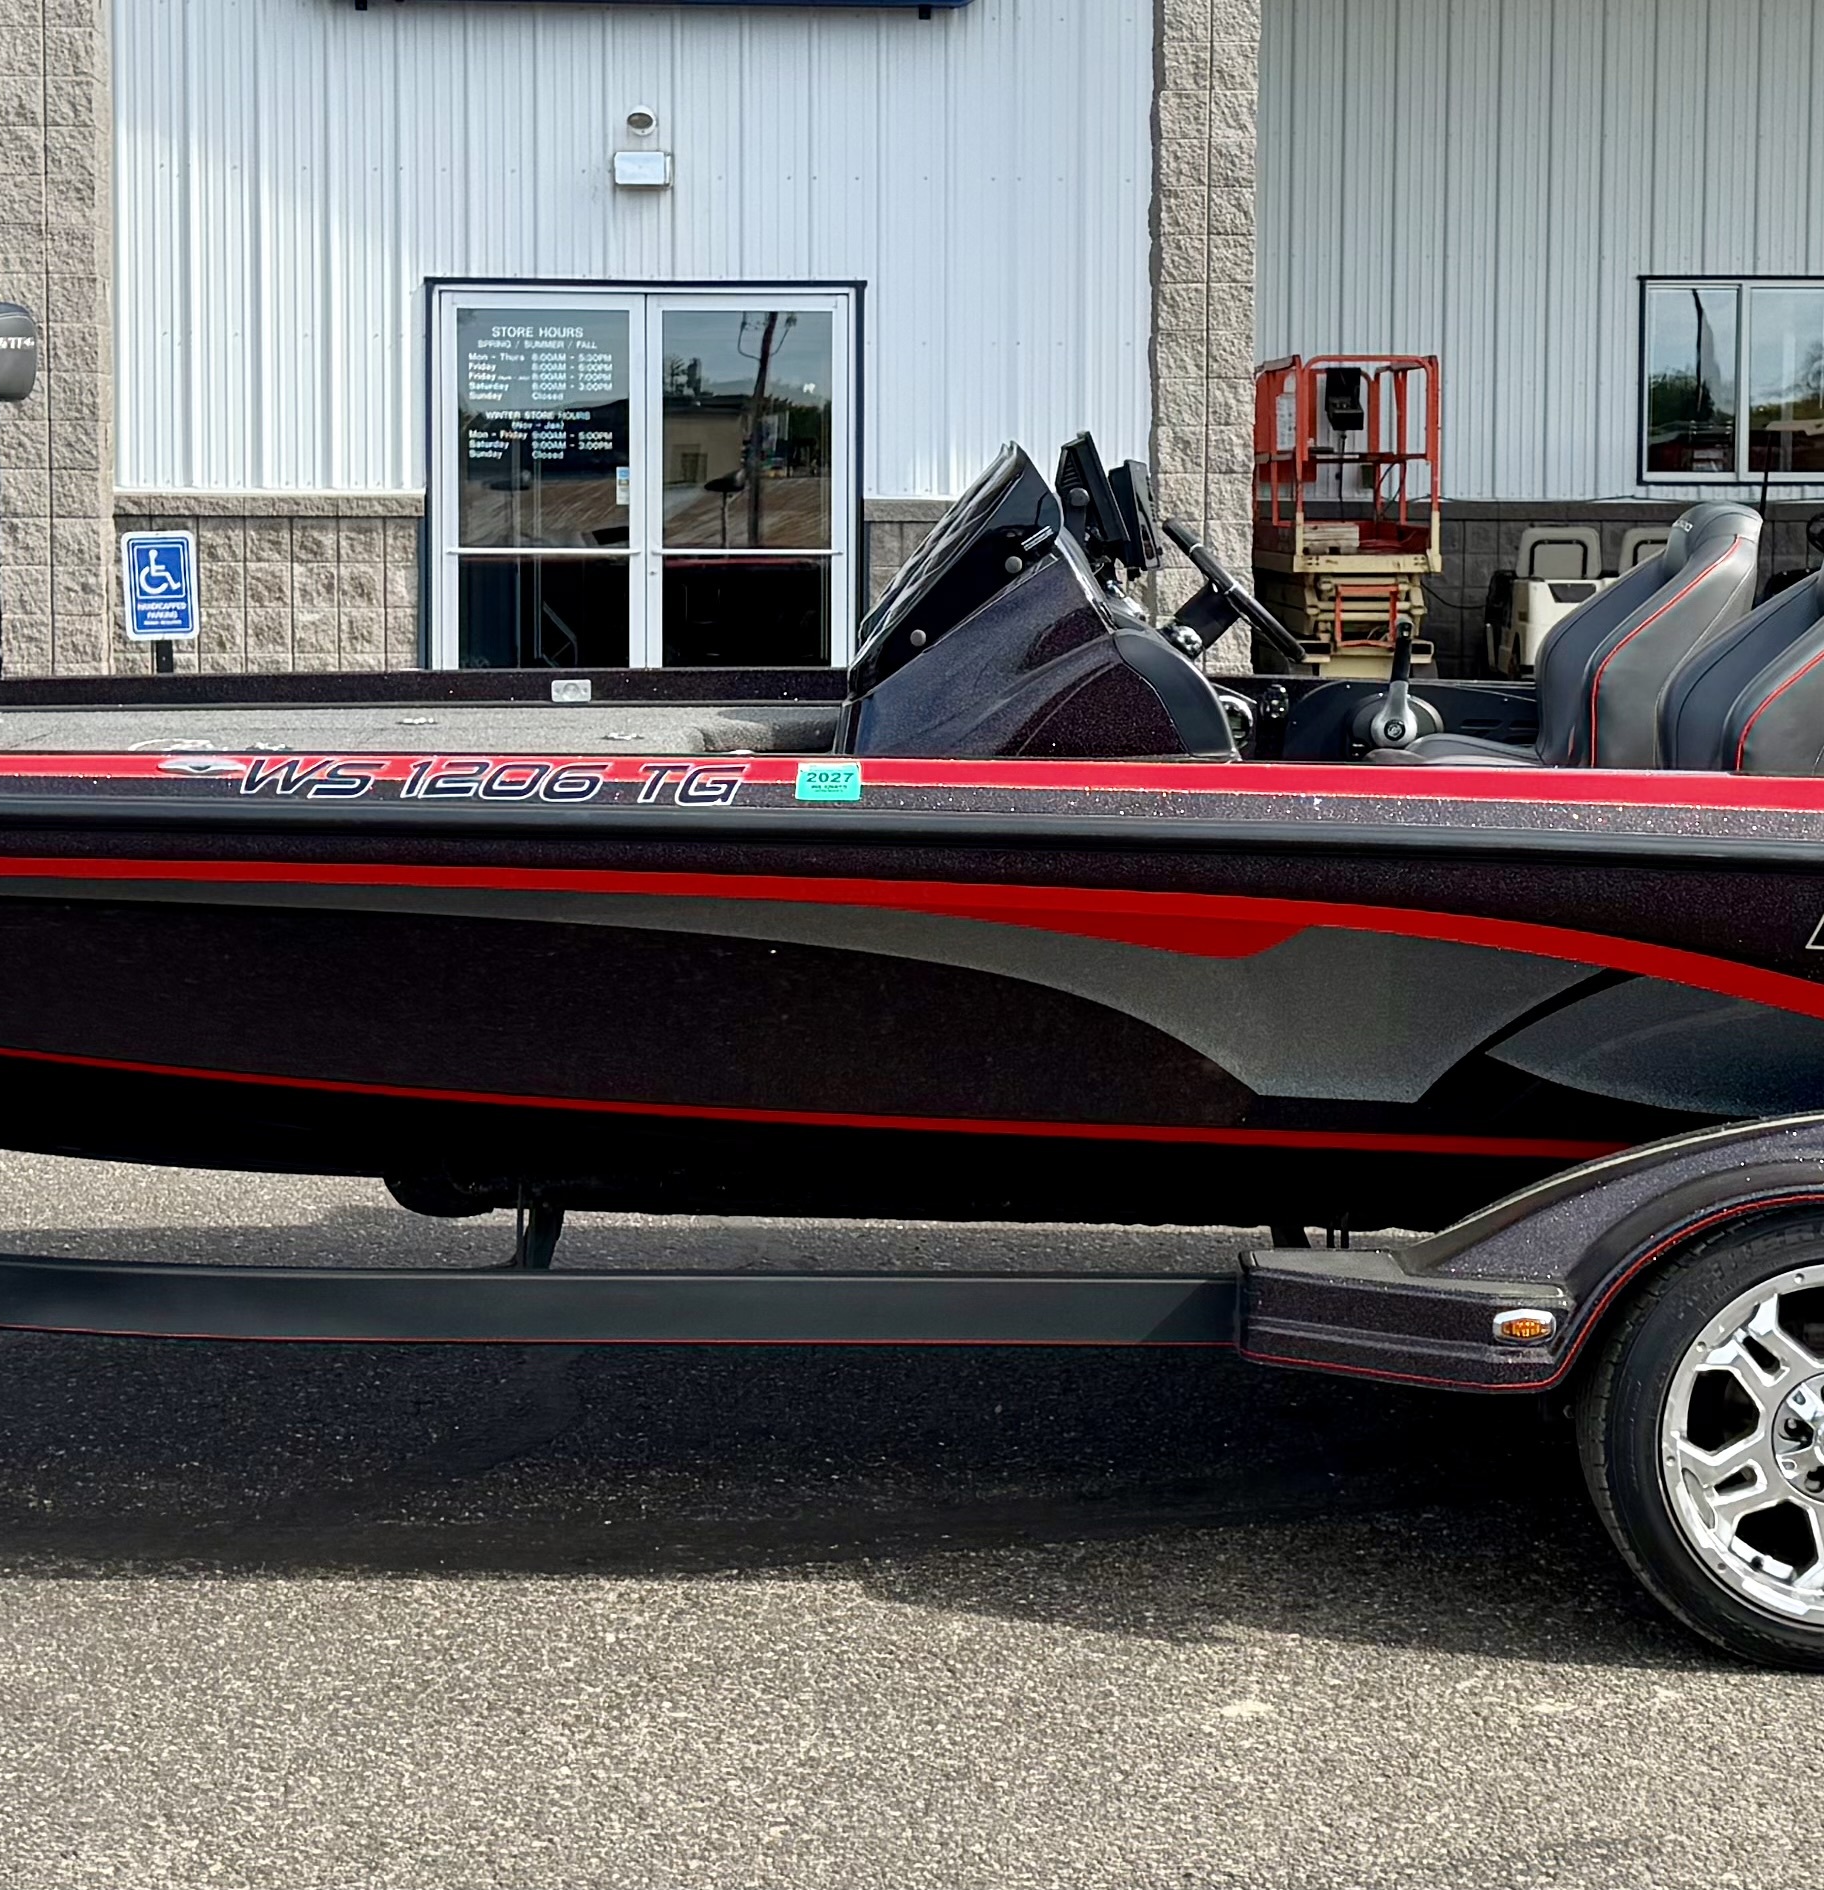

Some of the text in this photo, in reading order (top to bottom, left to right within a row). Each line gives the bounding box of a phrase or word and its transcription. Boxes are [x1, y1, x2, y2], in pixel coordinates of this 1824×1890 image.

[492, 326, 584, 338] STORE HOURS
[478, 340, 512, 349] SPRING
[524, 340, 564, 349] SUMMER
[576, 340, 597, 349] FALL
[468, 353, 488, 361] Mon
[468, 363, 496, 371] Friday
[468, 372, 496, 381] Friday
[469, 382, 509, 391] Saturday
[469, 392, 564, 400] Sunday Closed
[485, 411, 521, 420] WINTER
[524, 411, 555, 420] STORE
[468, 430, 489, 438] Mon
[499, 430, 528, 440] Friday
[469, 440, 510, 449] Saturday
[469, 450, 564, 459] Sunday Closed
[240, 757, 751, 807] WS 1206 TG
[806, 772, 854, 783] 2027
